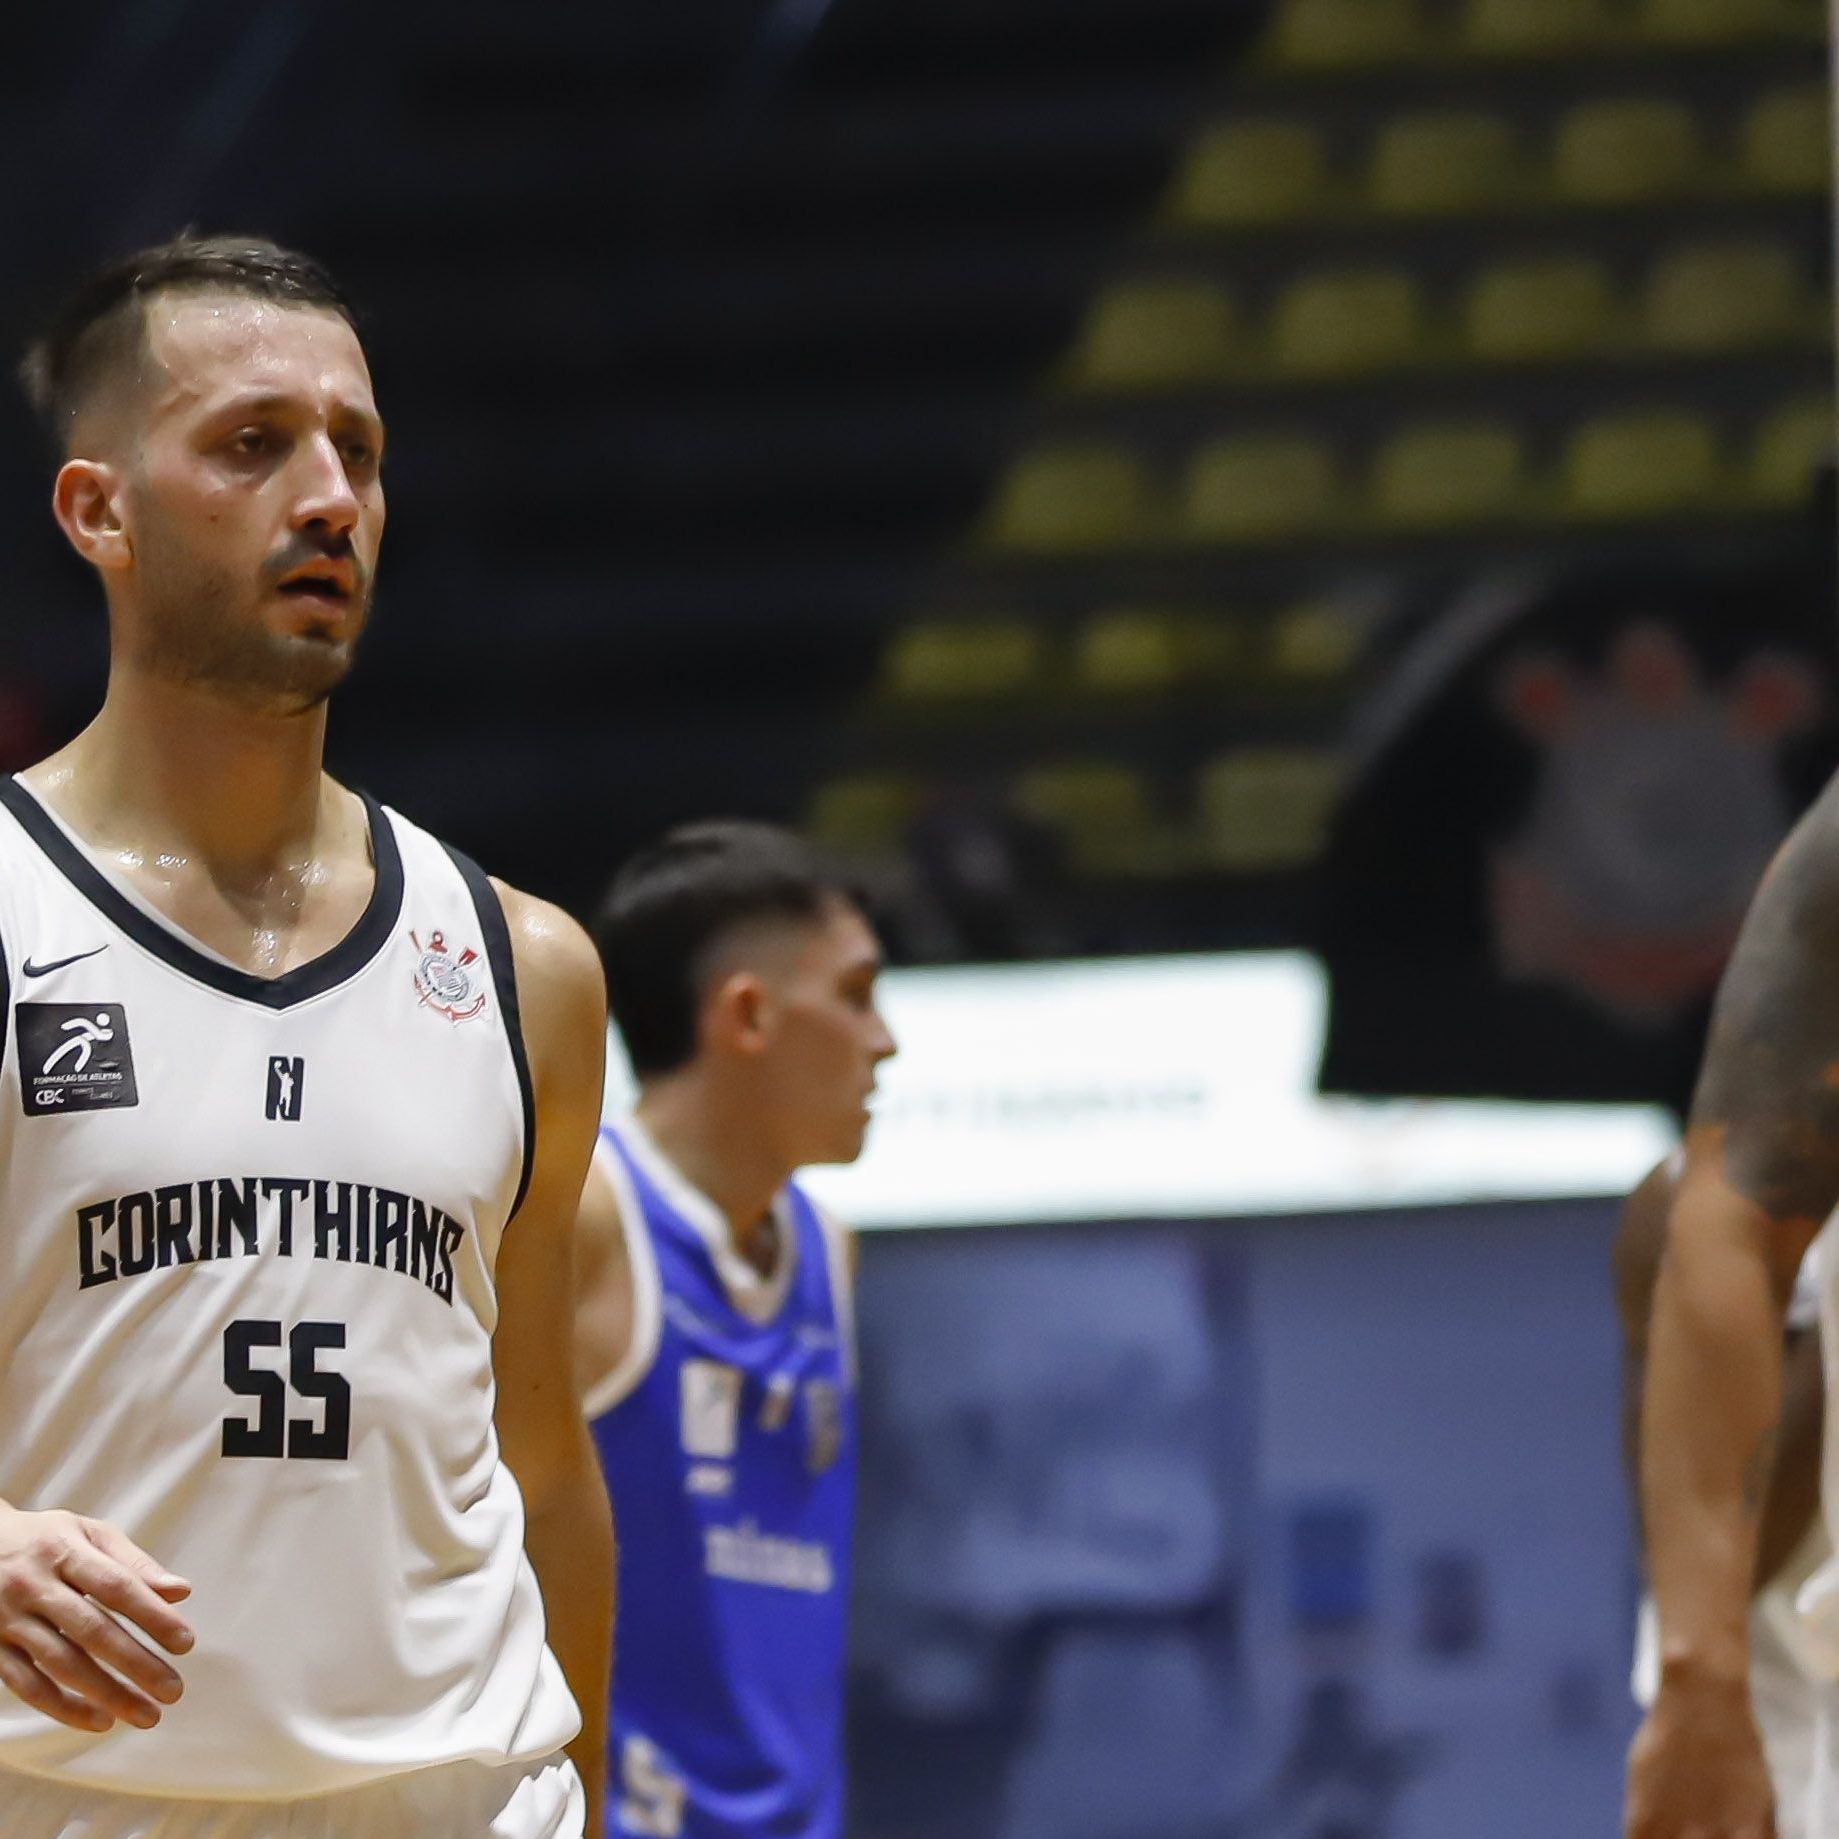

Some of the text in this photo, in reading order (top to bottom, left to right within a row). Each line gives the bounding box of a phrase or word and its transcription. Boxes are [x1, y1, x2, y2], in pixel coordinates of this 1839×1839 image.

[35, 1088, 65, 1105] CBC
[76, 1177, 465, 1307] CORINTHIANS
[221, 1319, 351, 1461] 55
